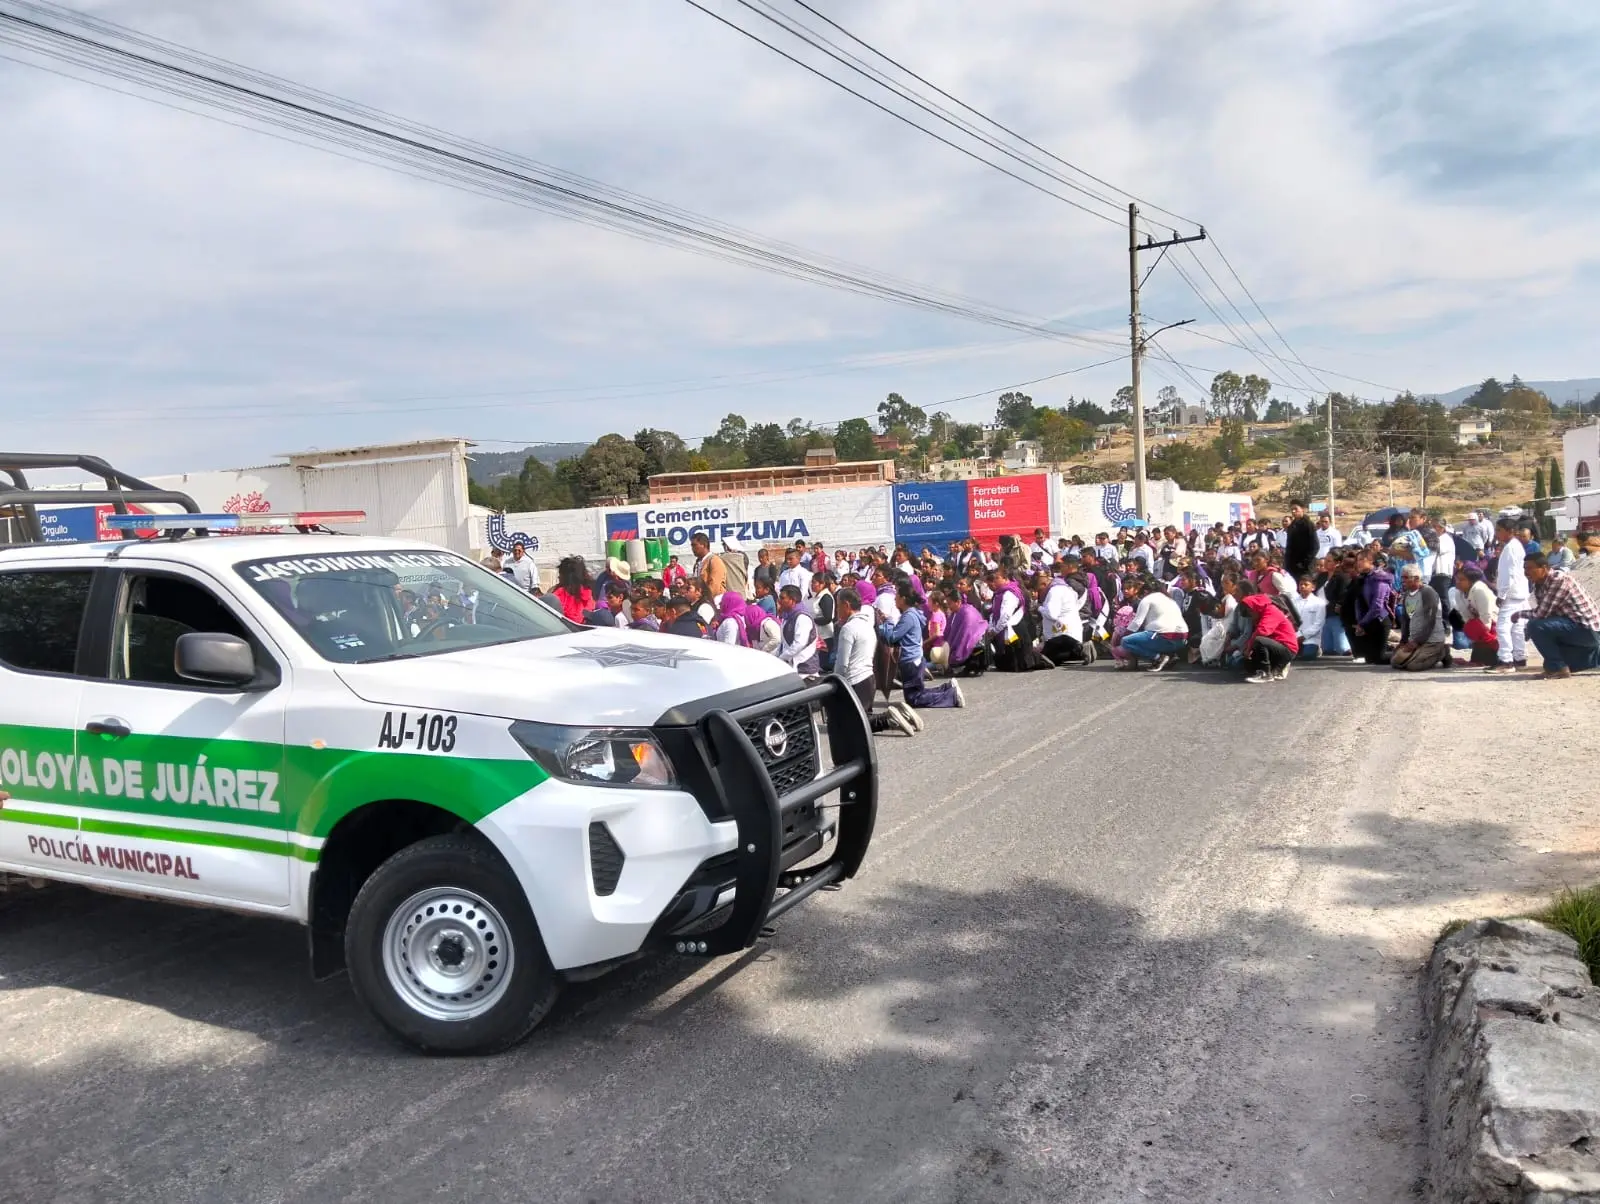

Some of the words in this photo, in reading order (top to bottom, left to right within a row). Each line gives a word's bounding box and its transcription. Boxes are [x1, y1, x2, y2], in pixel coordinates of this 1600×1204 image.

[972, 484, 1021, 496] Ferretería
[898, 492, 920, 501] Puro
[899, 502, 933, 513] Orgullo
[973, 498, 1004, 508] Mister
[40, 515, 58, 524] Puro
[645, 507, 729, 524] Cementos
[974, 509, 1006, 519] Bufalo
[899, 515, 945, 525] Mexicano.
[42, 525, 68, 536] Orgullo
[378, 711, 458, 753] AJ-103
[0, 748, 98, 794] OLOYA
[103, 758, 144, 799] DE
[151, 753, 280, 813] JUÁREZ
[28, 834, 95, 865] POLICÍA
[96, 846, 200, 880] MUNICIPAL
